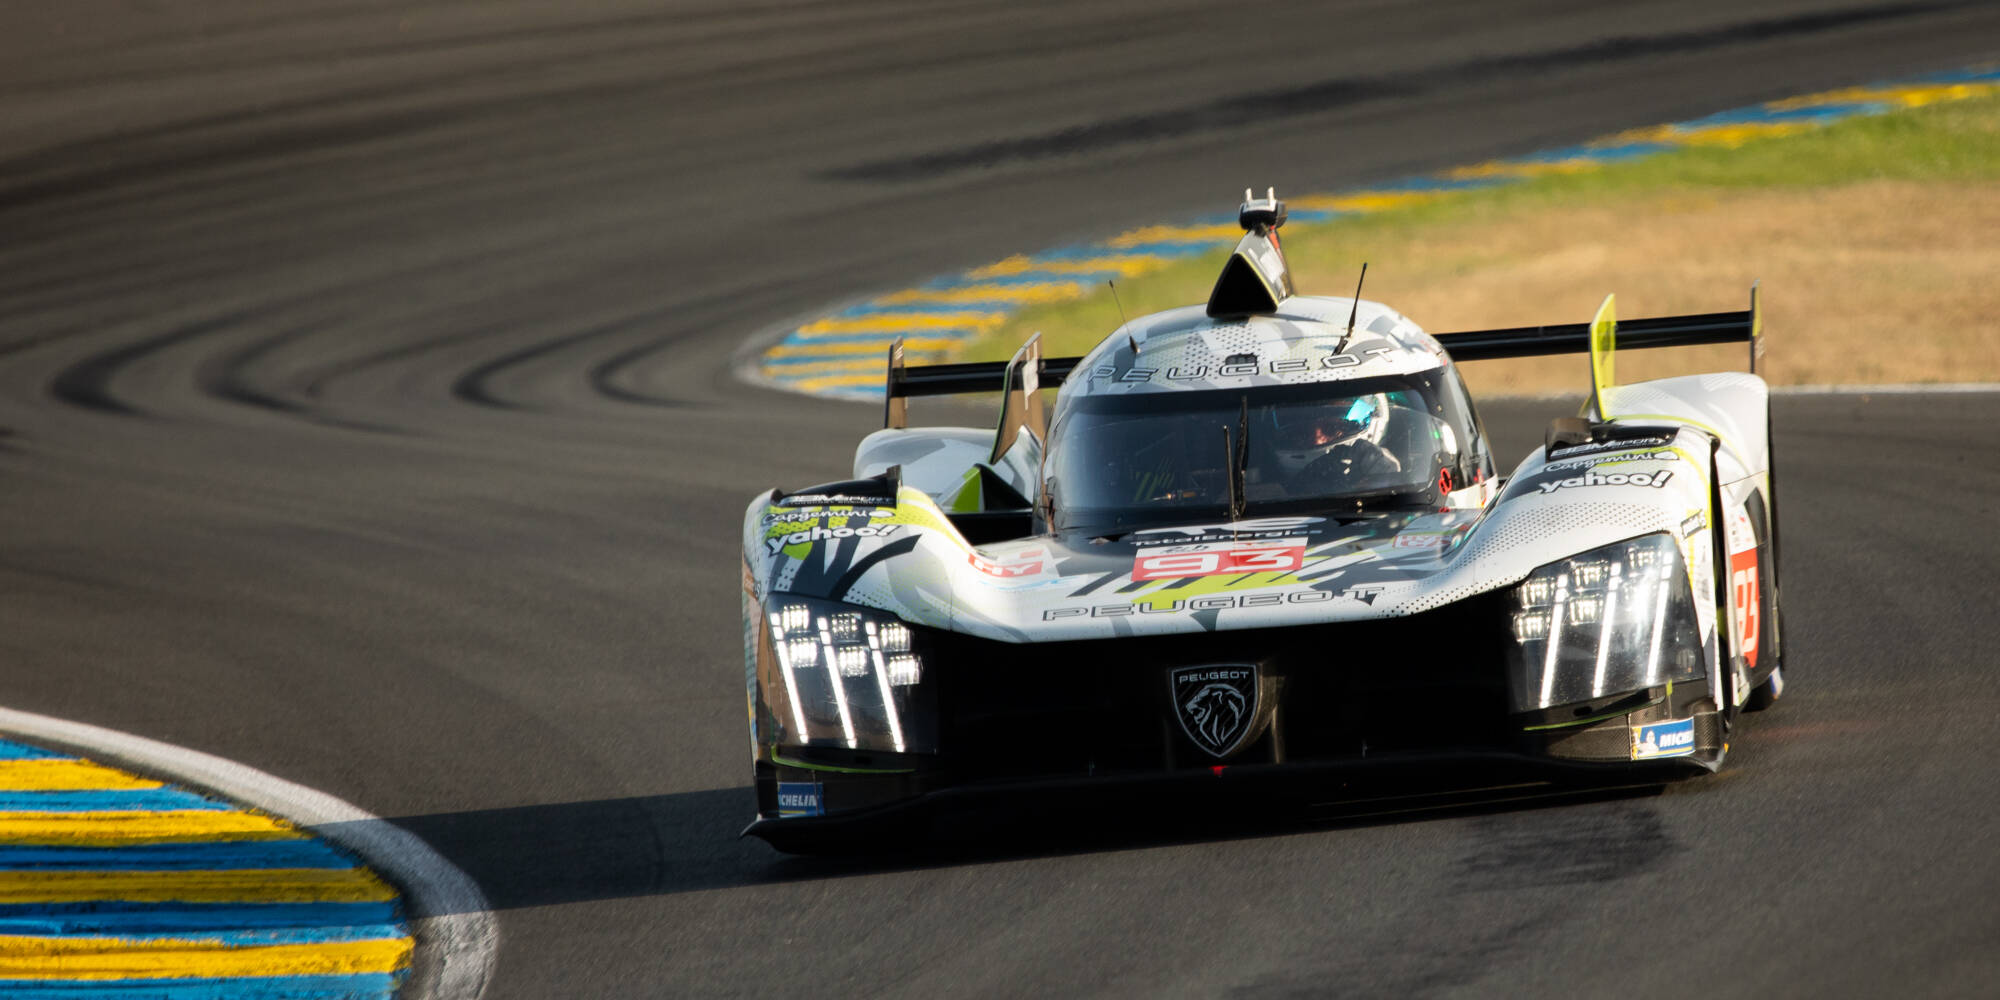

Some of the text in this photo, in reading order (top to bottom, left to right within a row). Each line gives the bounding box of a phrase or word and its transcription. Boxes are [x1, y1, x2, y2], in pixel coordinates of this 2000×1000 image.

[1088, 347, 1393, 382] PEUGEOT
[1545, 452, 1654, 472] Capgemini
[1539, 470, 1674, 494] yahoo!
[763, 510, 868, 523] Capgemini
[767, 525, 900, 557] yahoo!
[1143, 549, 1294, 578] 93
[1042, 587, 1385, 621] PEUGEOT
[1179, 671, 1249, 684] PEUGEOT
